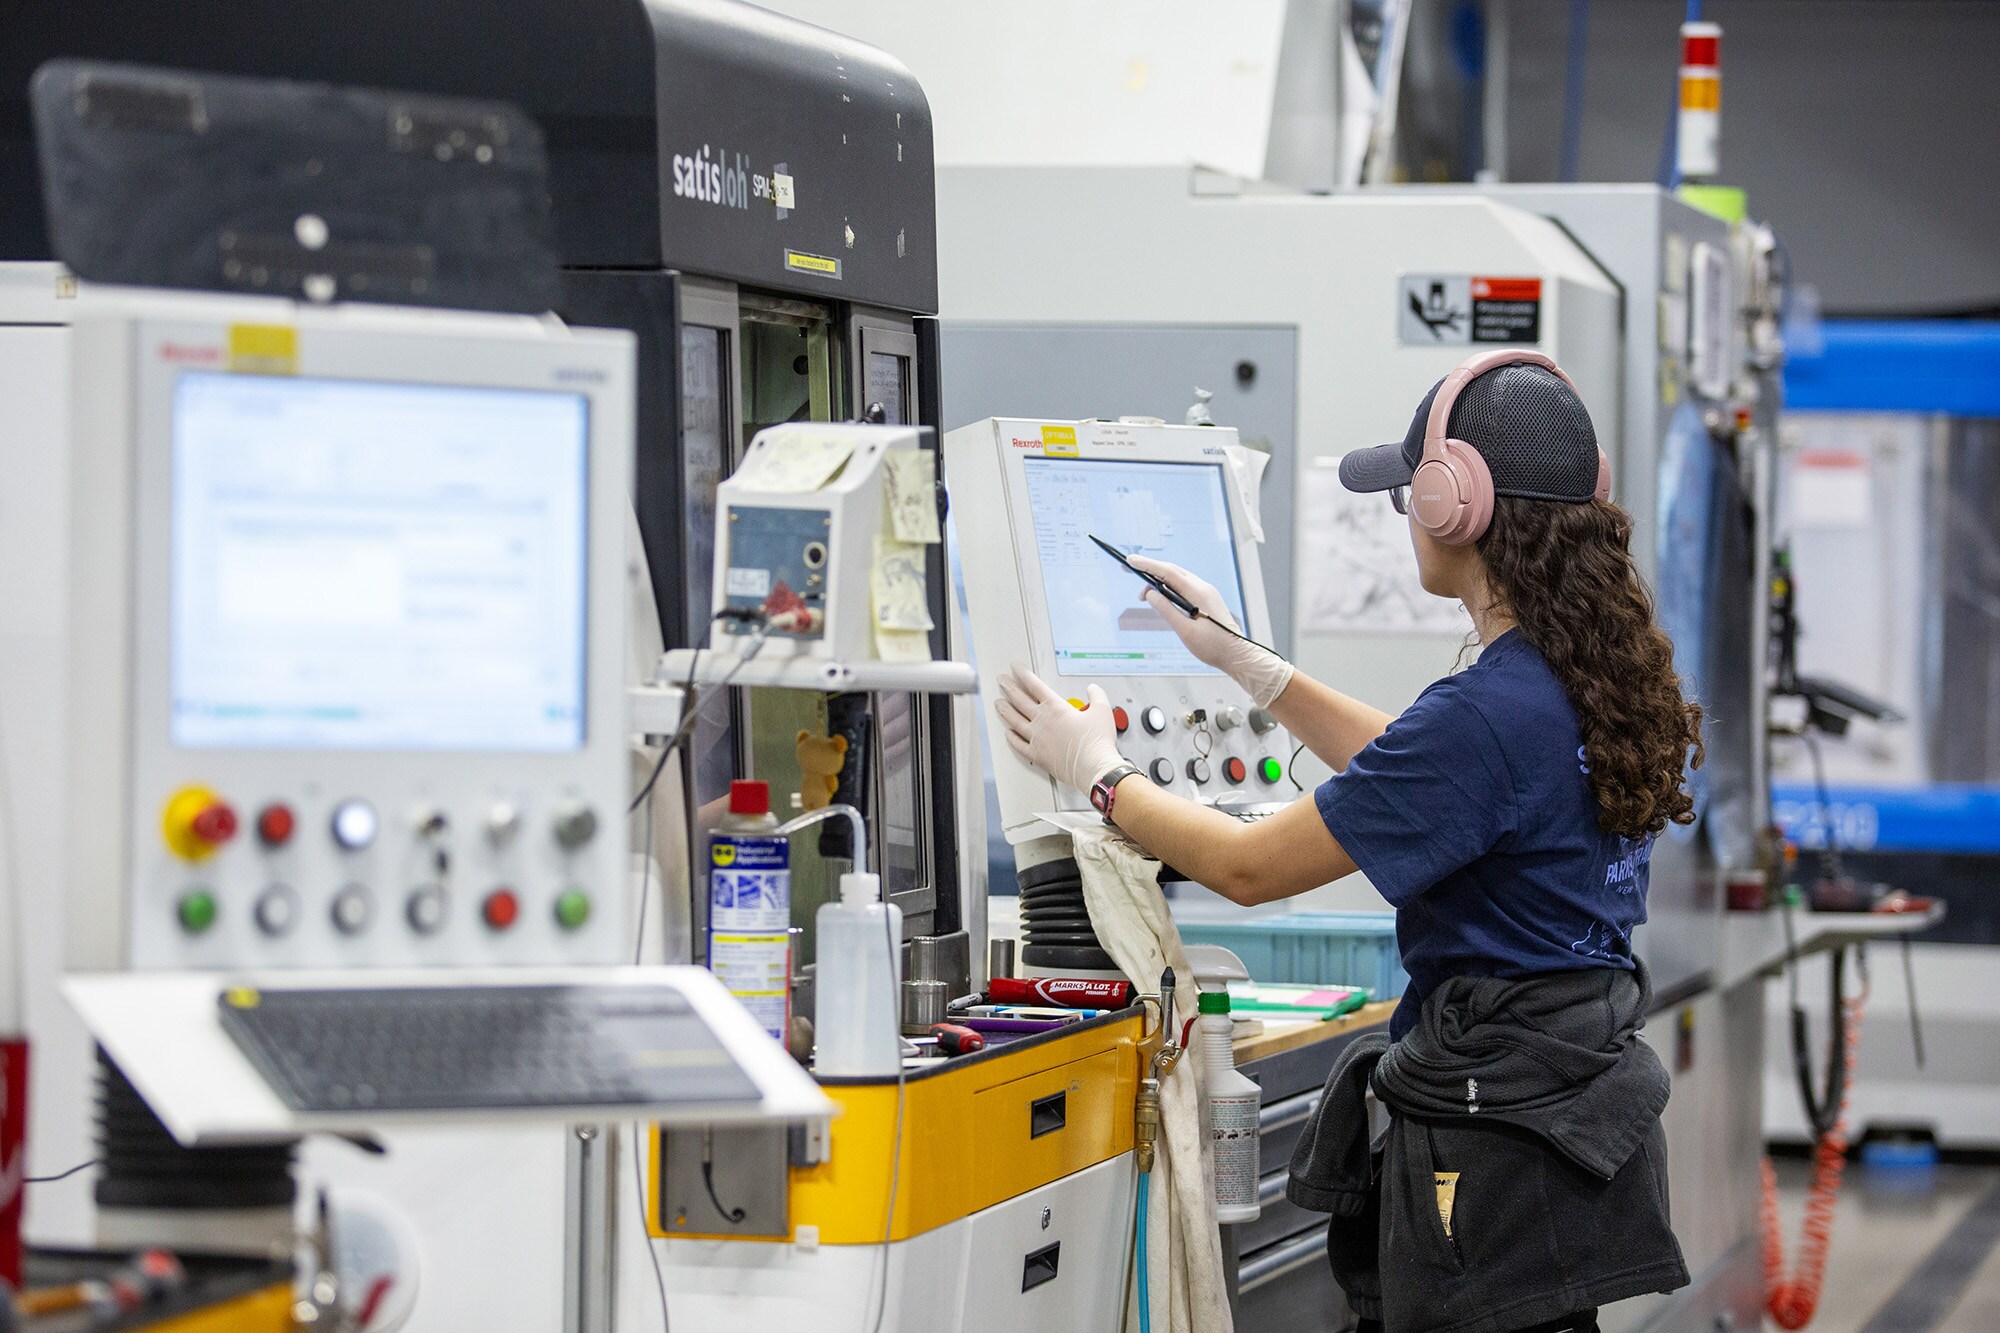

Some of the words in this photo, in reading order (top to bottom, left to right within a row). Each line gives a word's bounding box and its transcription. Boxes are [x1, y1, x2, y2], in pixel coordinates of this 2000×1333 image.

[673, 143, 748, 210] satisloh
[1044, 431, 1074, 440] OPTIMAX
[1012, 437, 1043, 449] Rexroth
